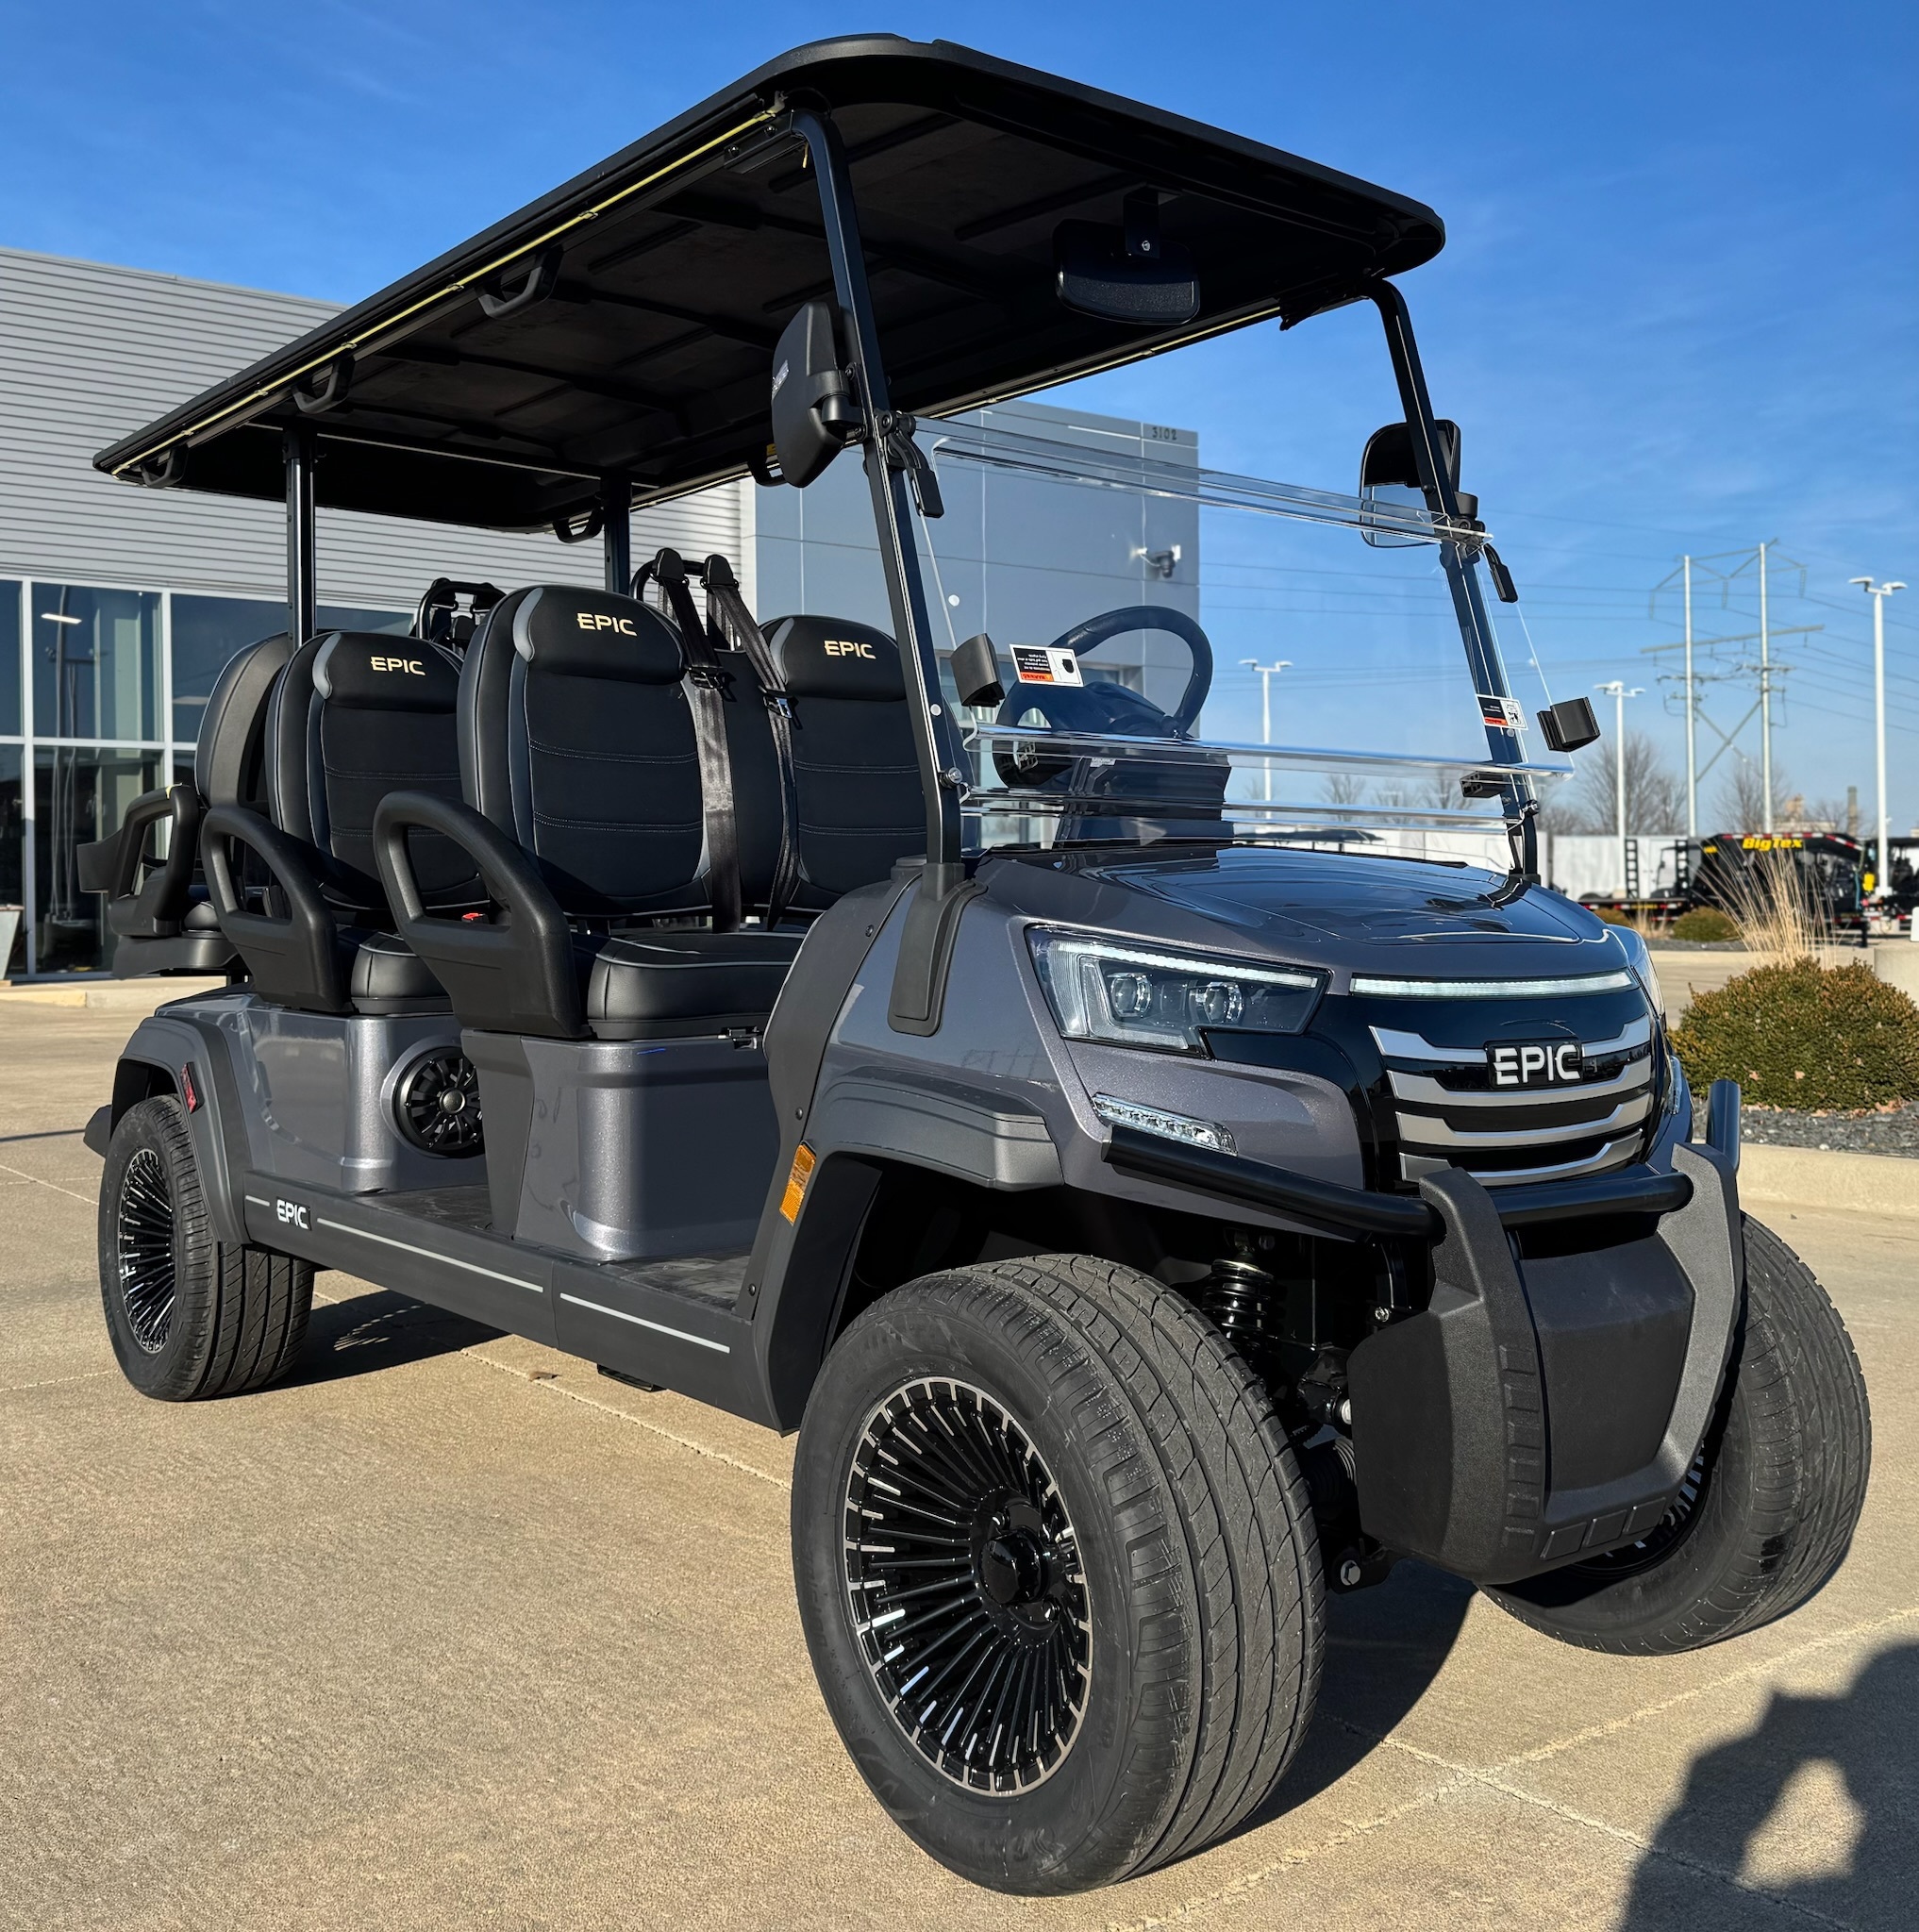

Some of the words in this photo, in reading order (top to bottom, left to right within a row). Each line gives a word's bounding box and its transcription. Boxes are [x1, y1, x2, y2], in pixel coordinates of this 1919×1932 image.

[1152, 426, 1177, 441] 3102
[576, 612, 638, 637] EPIC
[824, 640, 876, 659] EPIC
[370, 656, 426, 676] EPIC
[1493, 1043, 1581, 1086] EPIC
[276, 1199, 309, 1230] EPIC
